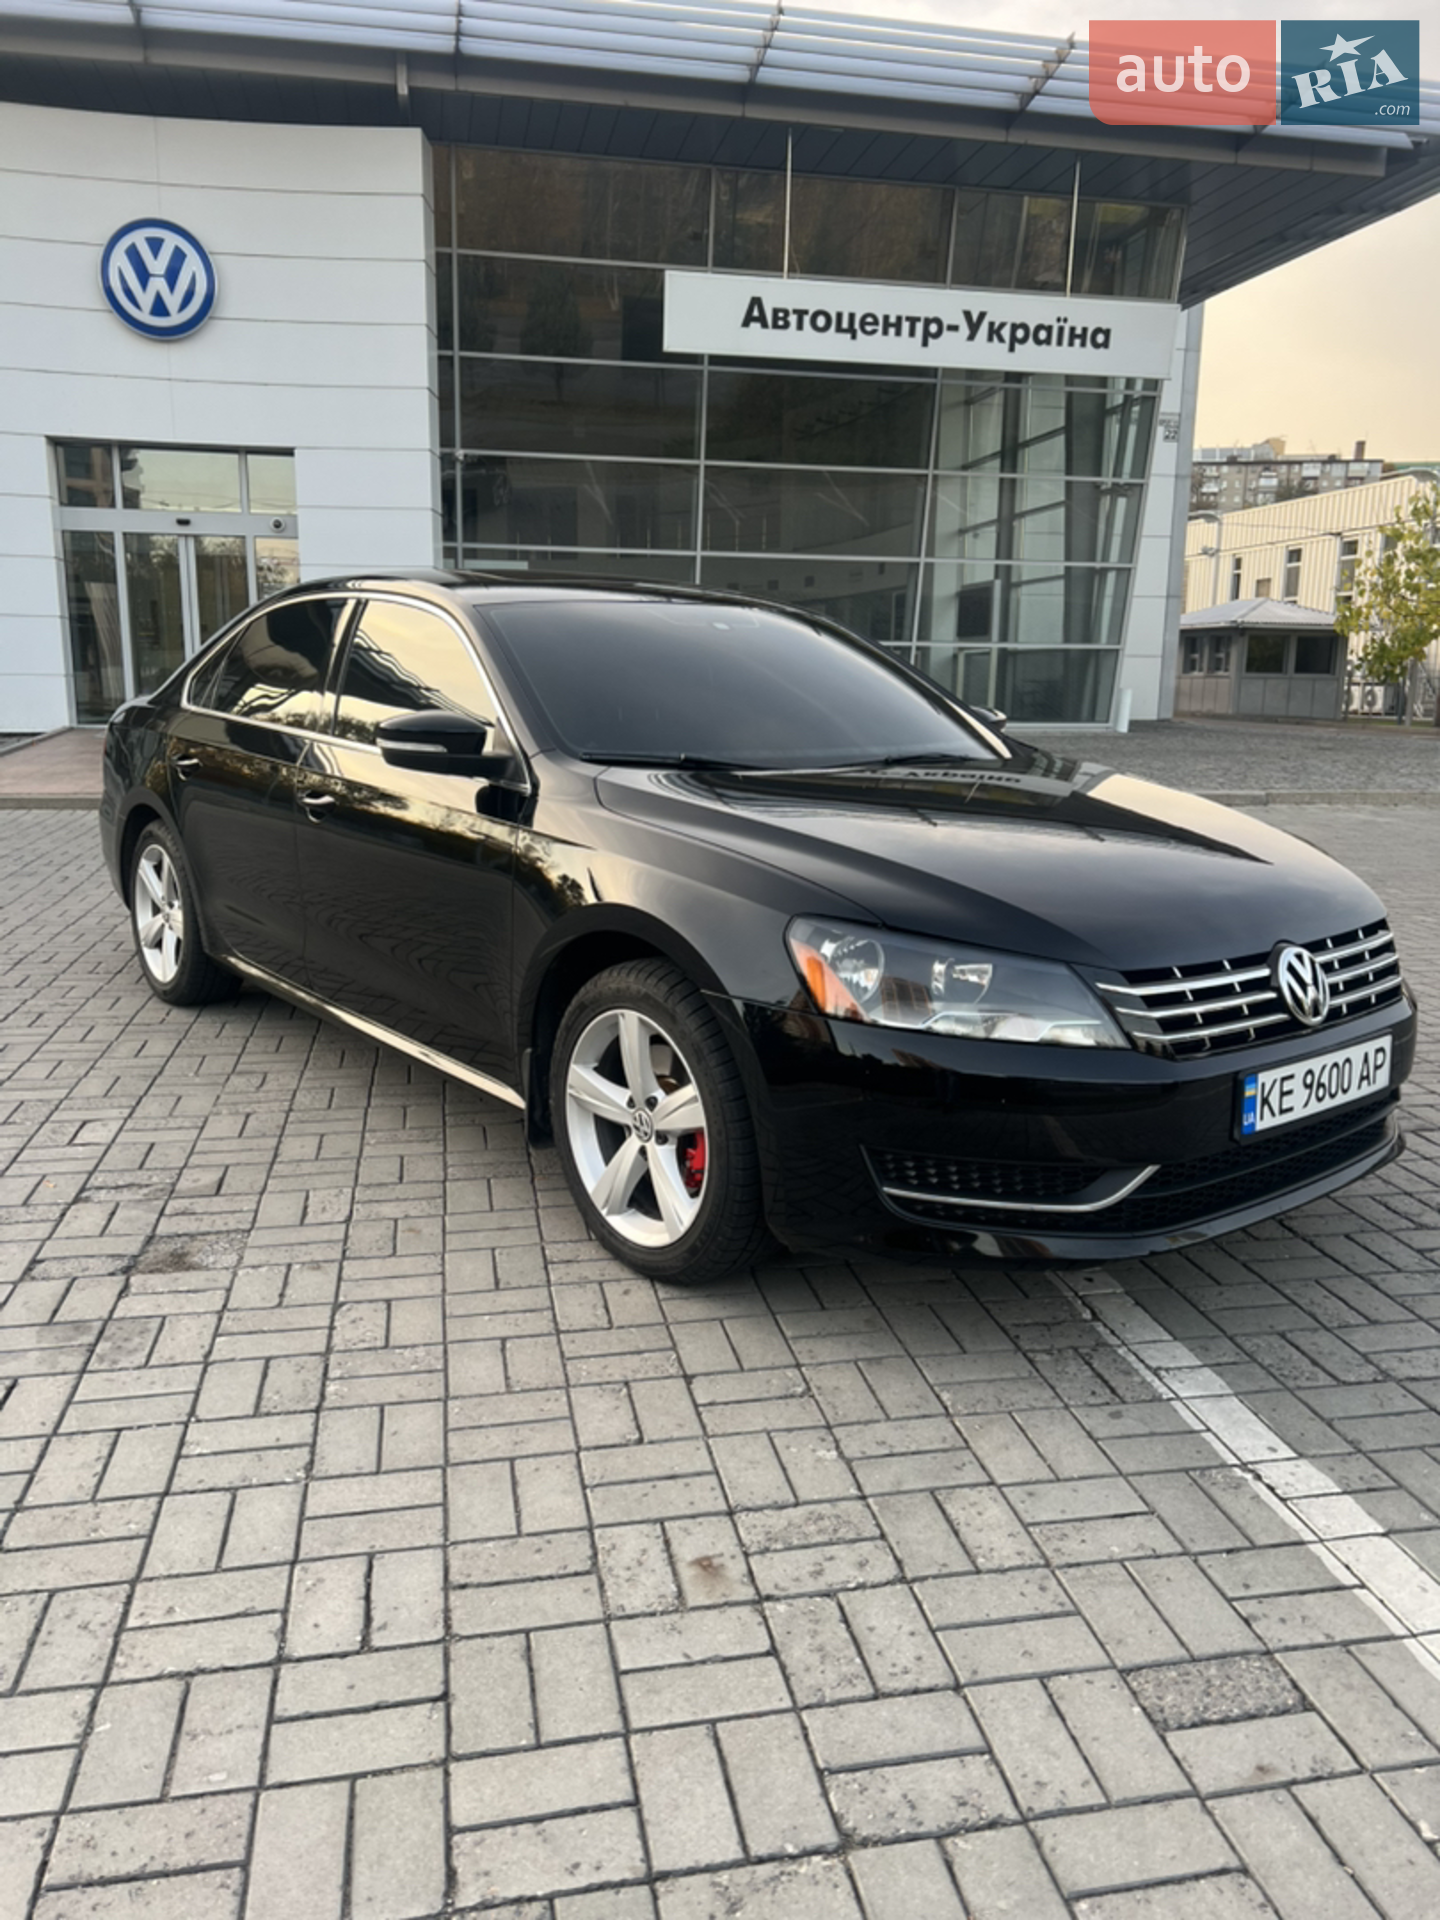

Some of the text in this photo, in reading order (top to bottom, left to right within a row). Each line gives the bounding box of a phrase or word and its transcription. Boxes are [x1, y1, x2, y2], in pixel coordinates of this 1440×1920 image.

[741, 296, 1112, 353] Автоцентр-Україна
[1259, 1046, 1387, 1121] KE 9600 AP
